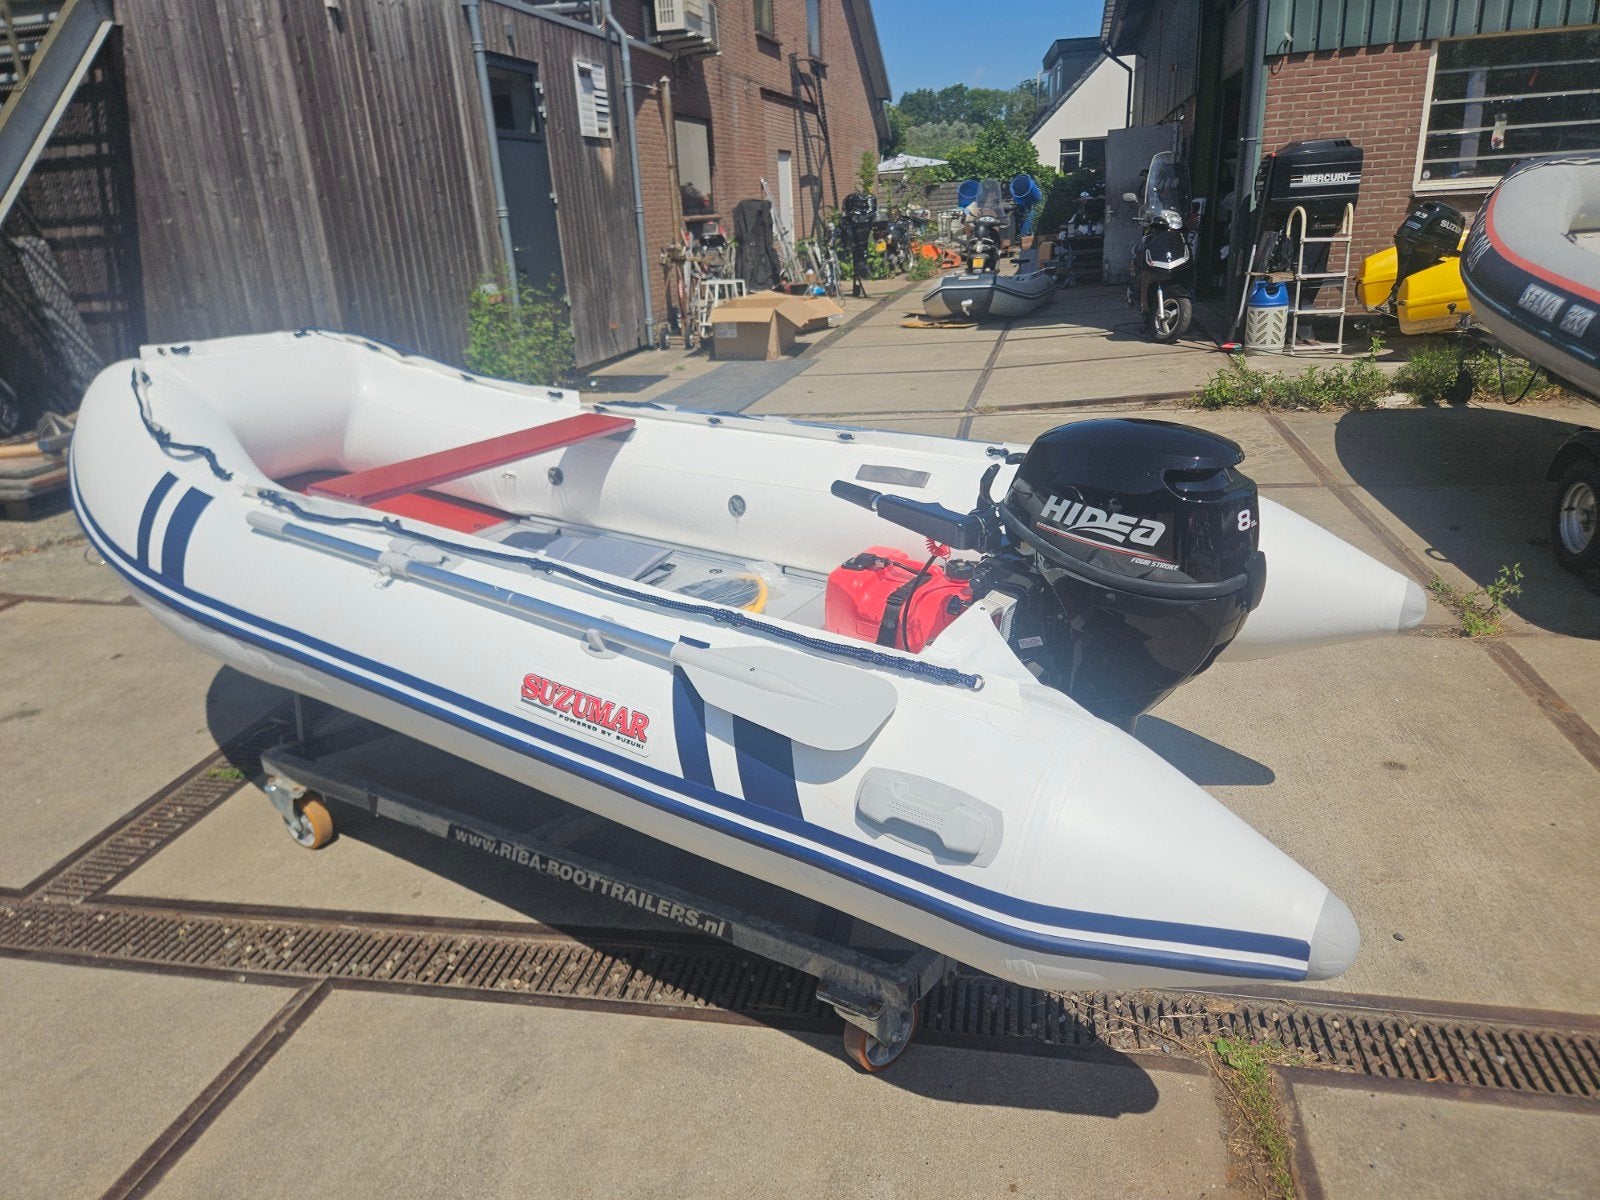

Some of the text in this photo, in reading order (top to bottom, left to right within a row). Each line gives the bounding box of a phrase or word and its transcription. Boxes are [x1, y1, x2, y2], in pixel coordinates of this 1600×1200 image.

[1302, 172, 1350, 184] MERCURY
[1130, 557, 1180, 571] FOUR STROKE
[521, 673, 649, 743] SUZUMAR
[559, 714, 644, 750] POWERED BY SUZUKI
